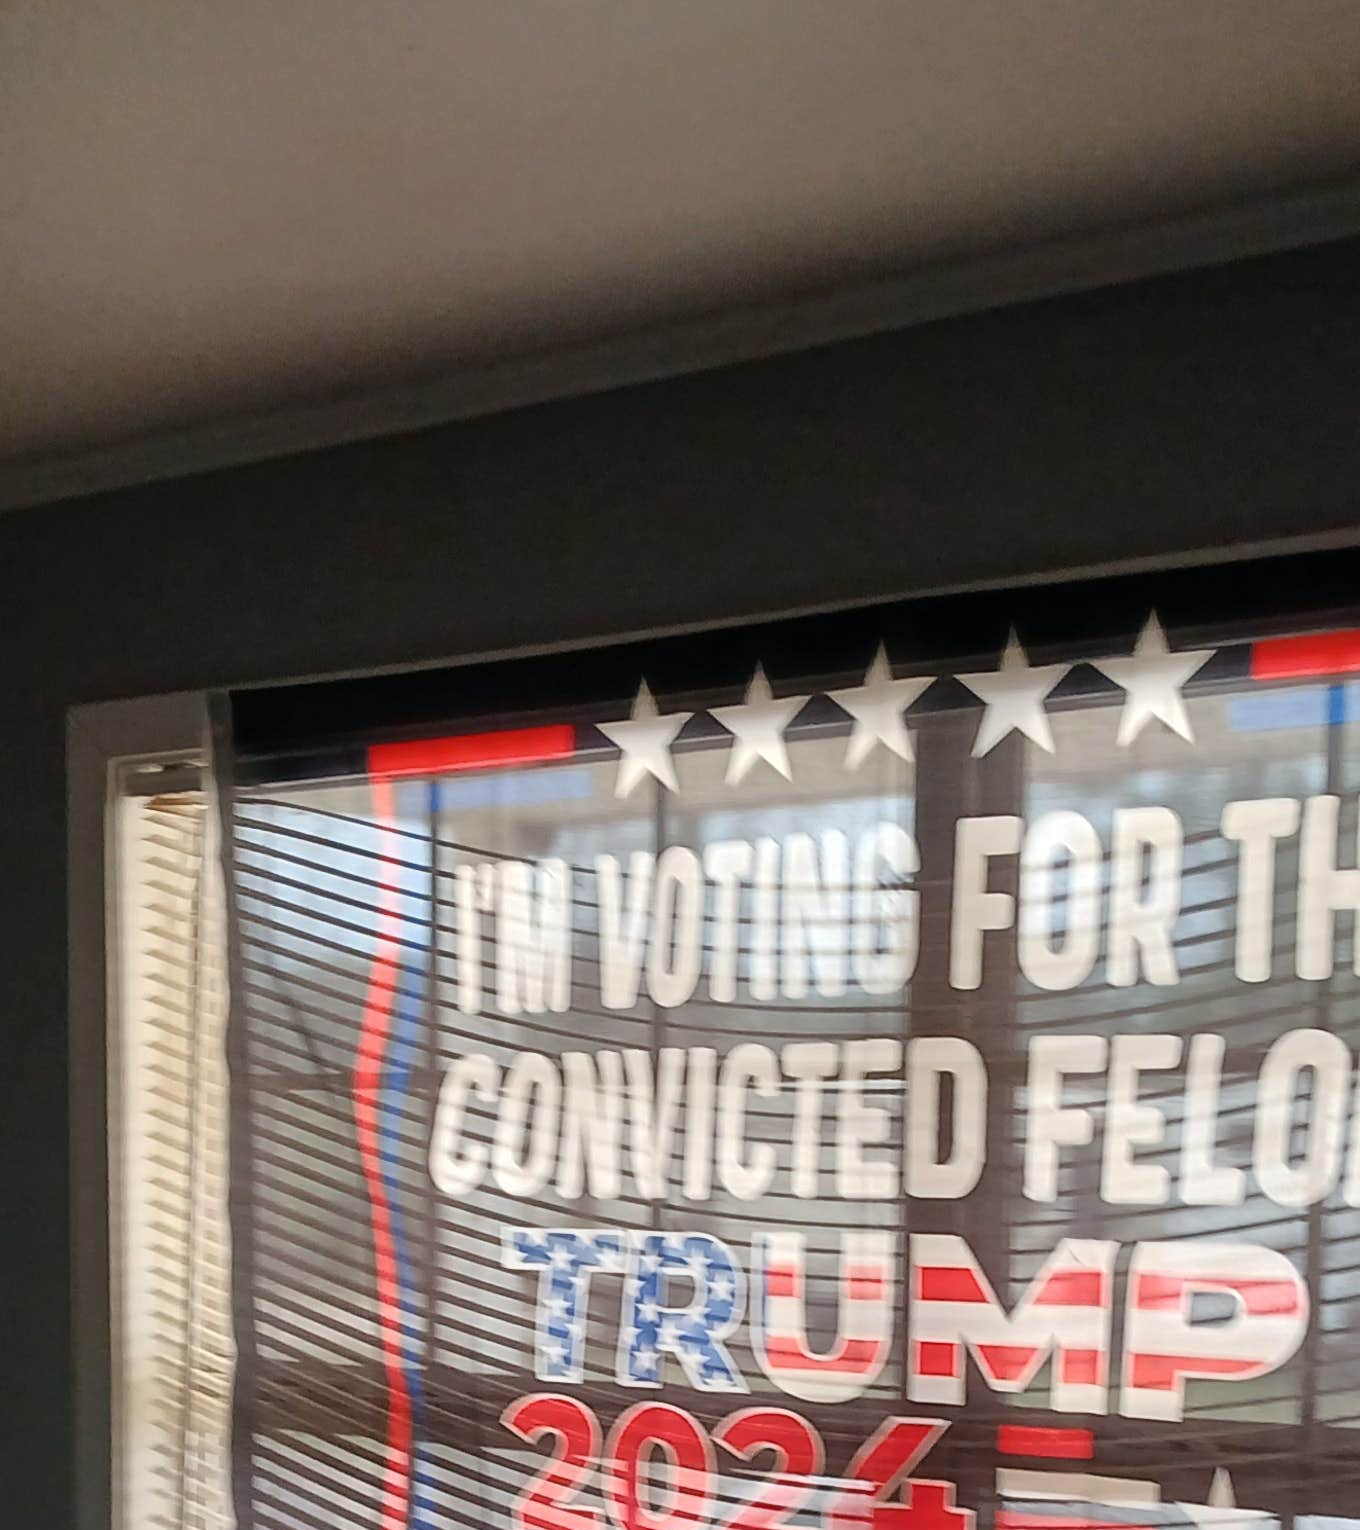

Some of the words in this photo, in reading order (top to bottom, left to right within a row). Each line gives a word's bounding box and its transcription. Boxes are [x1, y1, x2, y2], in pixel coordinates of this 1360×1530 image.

[453, 858, 572, 1015] I'M
[595, 822, 922, 1009] VOTING
[949, 806, 1185, 991] FOR
[428, 1036, 988, 1200] CONVICTED
[500, 1228, 1310, 1422] TRUMP
